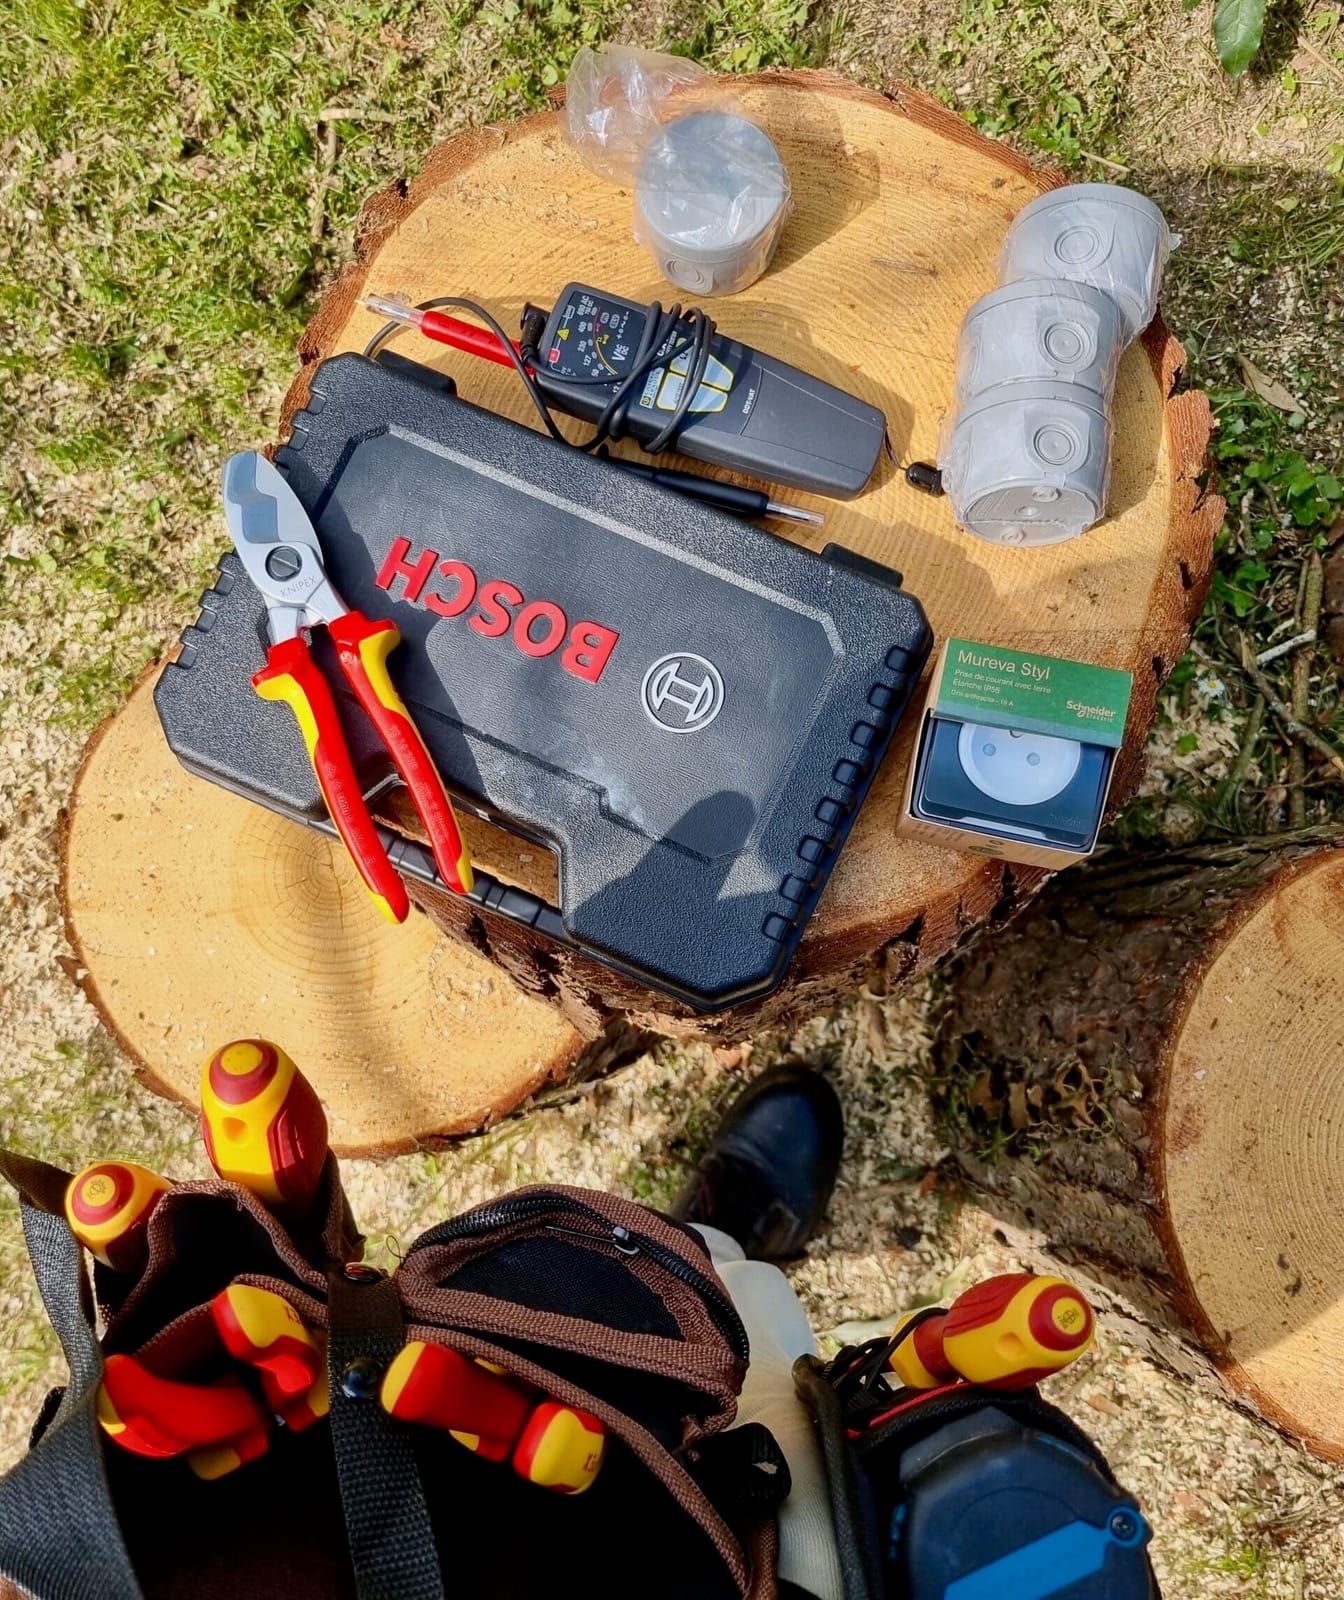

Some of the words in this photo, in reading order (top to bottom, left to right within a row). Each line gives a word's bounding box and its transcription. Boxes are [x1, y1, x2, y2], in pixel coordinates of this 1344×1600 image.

[580, 294, 590, 306] AC
[581, 355, 593, 367] 127
[279, 574, 317, 598] KNIPEX
[375, 536, 620, 685] BOSCH
[958, 650, 1015, 673] Mureva
[1021, 661, 1050, 683] Styl
[955, 669, 974, 678] Prise
[975, 672, 985, 681] de
[986, 676, 1013, 687] courant
[1015, 681, 1032, 690] avec
[1033, 684, 1051, 694] terre
[983, 685, 1000, 694] IP55
[1066, 700, 1116, 718] Schneider
